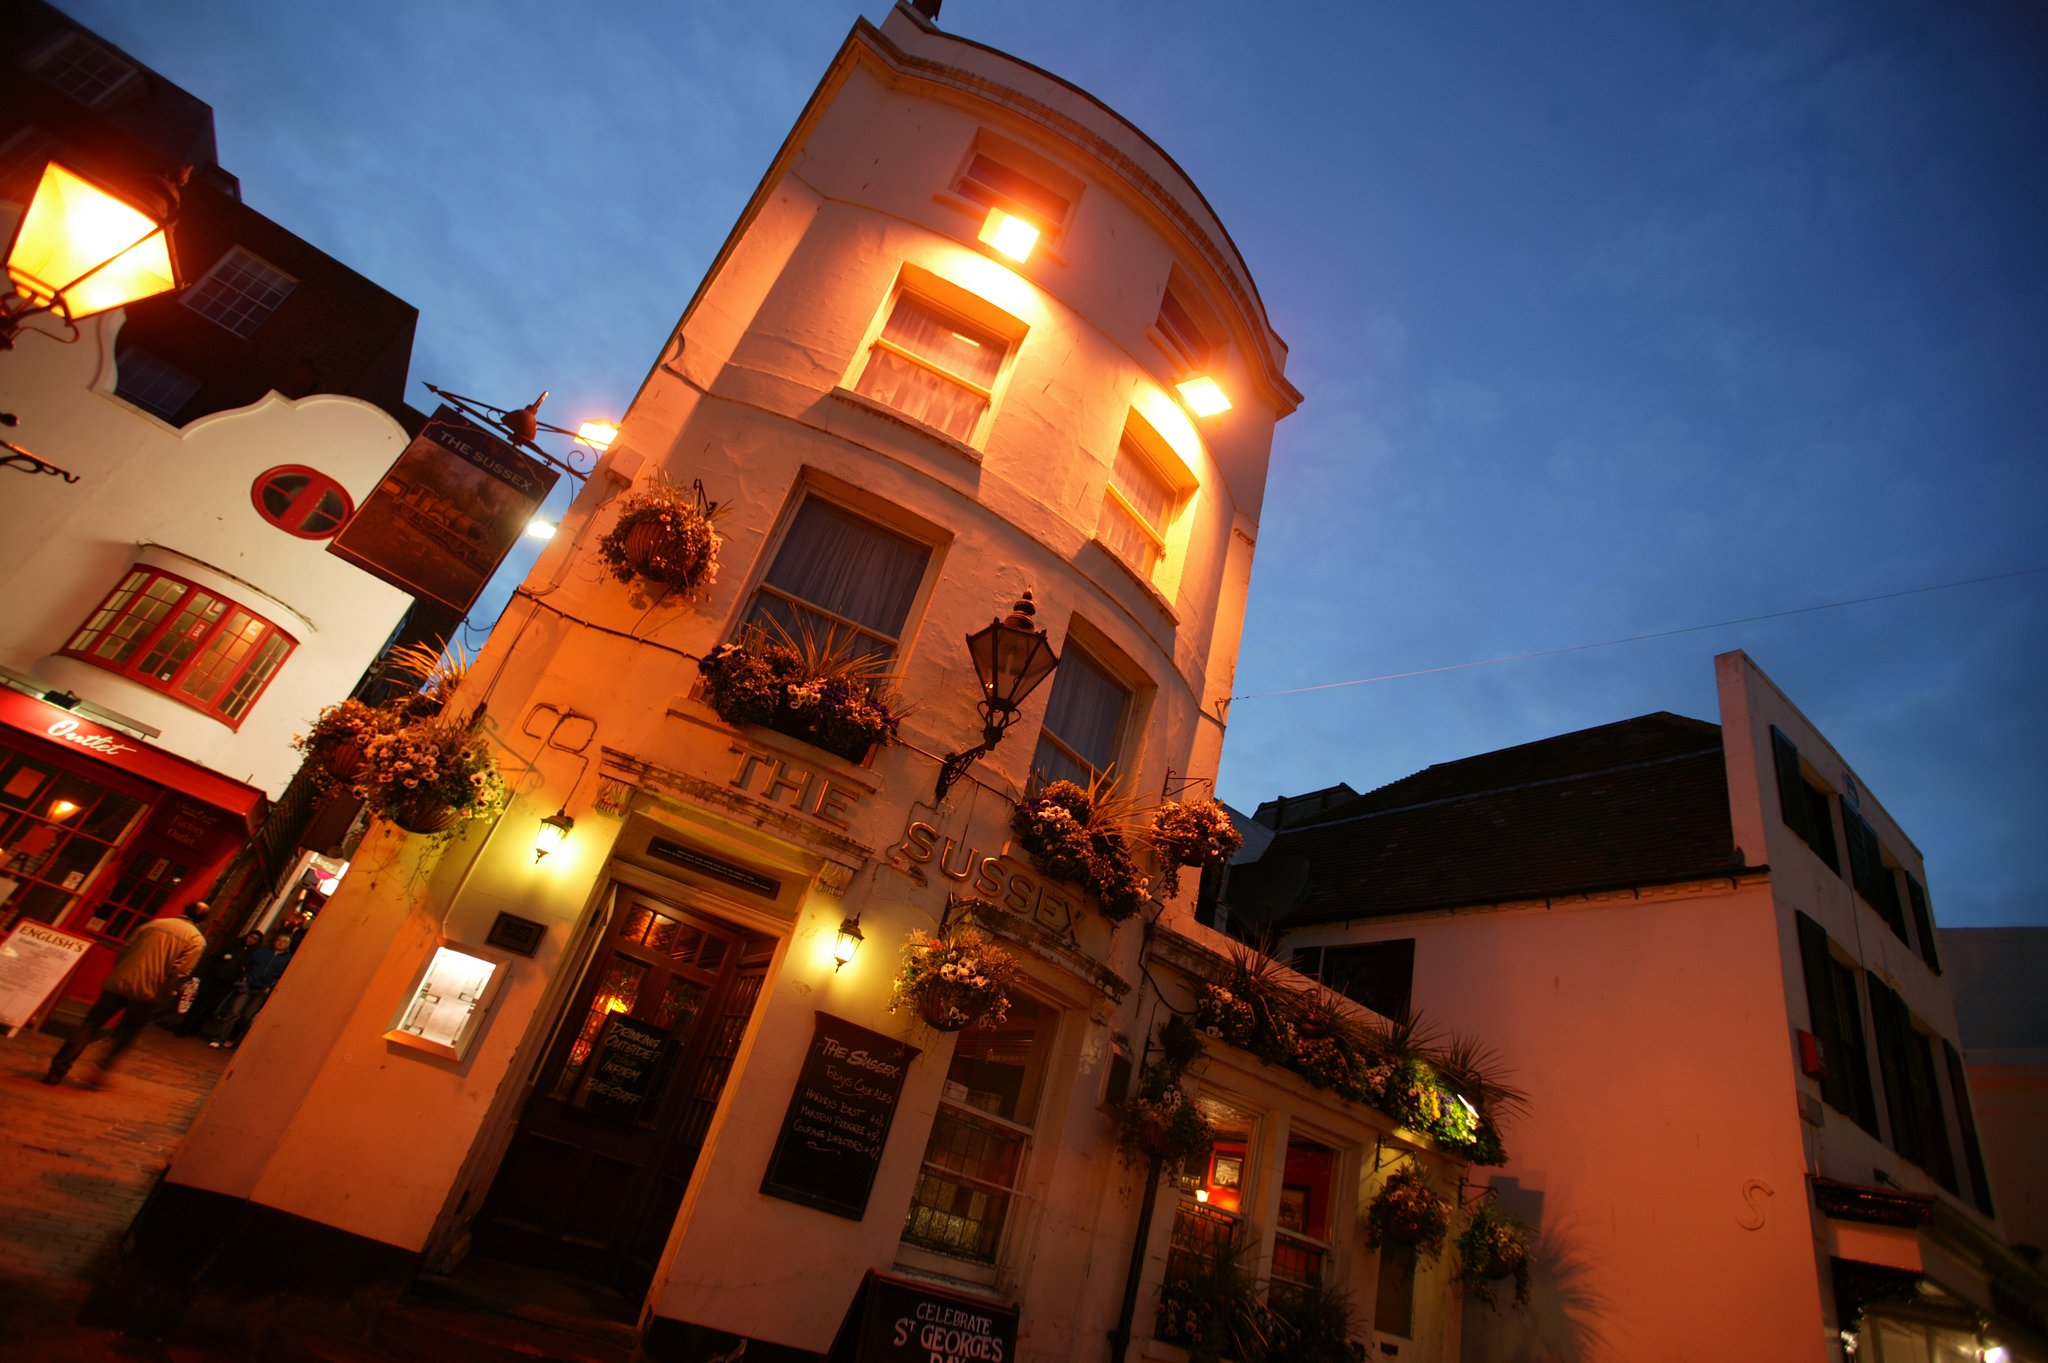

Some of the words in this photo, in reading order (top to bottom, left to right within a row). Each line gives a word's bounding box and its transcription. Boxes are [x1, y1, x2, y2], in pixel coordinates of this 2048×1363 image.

[441, 430, 473, 455] THE
[472, 450, 533, 491] SUSSEX
[47, 719, 137, 755] Outlet
[728, 742, 860, 831] THE
[900, 821, 1082, 948] SUSSEX
[19, 925, 86, 953] ENGLISH'S
[601, 1062, 642, 1082] INFORM
[822, 1035, 849, 1059] THE
[846, 1050, 900, 1079] SUSSEX
[584, 1077, 610, 1094] BAR
[608, 1086, 642, 1105] STAFF
[916, 1302, 992, 1335] CELEBRATE
[920, 1324, 1003, 1363] GEORGES
